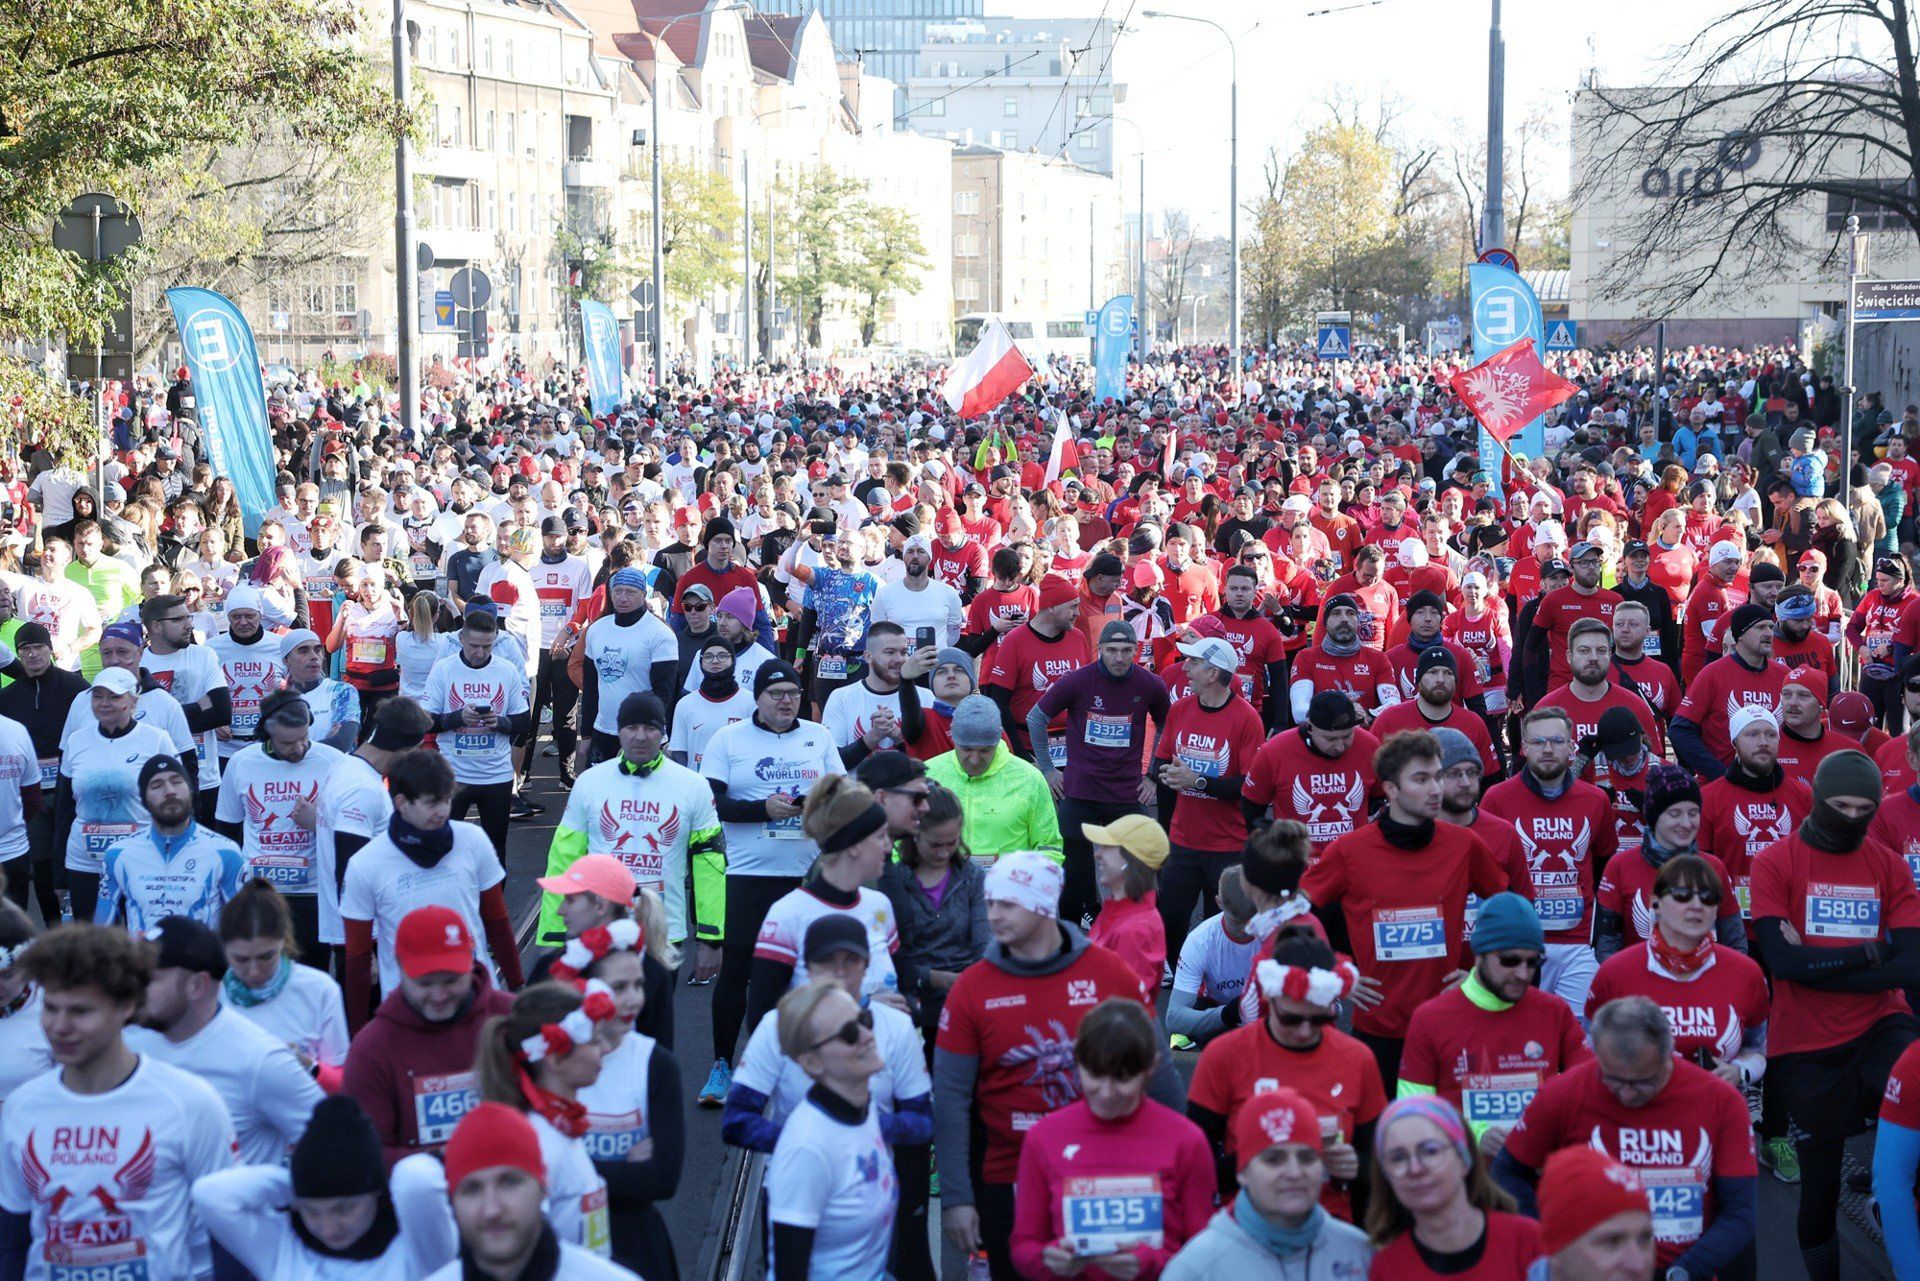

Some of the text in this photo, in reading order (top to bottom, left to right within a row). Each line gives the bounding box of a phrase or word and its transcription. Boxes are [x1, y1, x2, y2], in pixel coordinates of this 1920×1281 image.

[999, 605, 1021, 613] RUN
[234, 662, 261, 672] RUN
[1046, 661, 1070, 670] RUN
[464, 683, 490, 693] RUN
[1743, 691, 1771, 703] RUN
[1093, 724, 1124, 735] 3312
[1577, 724, 1598, 735] RU
[458, 736, 489, 746] 4110
[1187, 734, 1216, 749] RUN
[766, 770, 818, 779] WORLD RUN
[1310, 773, 1346, 787] RUN
[265, 782, 300, 795] RUN
[1311, 784, 1346, 795] POLAND
[621, 800, 659, 814] RUN
[1748, 803, 1776, 814] RUN
[619, 813, 660, 823] POLAND
[1533, 818, 1573, 831] RUN
[1309, 822, 1352, 835] TEAM
[262, 832, 308, 844] TEAM
[1534, 831, 1573, 840] POLAND
[258, 868, 299, 881] 1492
[1531, 872, 1577, 885] TEAM
[1533, 902, 1576, 915] 4393
[1818, 899, 1869, 920] 5816
[1385, 923, 1434, 943] 2775
[1660, 1005, 1715, 1026] RUN
[1669, 1025, 1717, 1037] OLAND
[54, 1126, 119, 1150] RUN
[1619, 1127, 1682, 1152] RUN
[51, 1151, 117, 1165] POLAND
[1621, 1151, 1684, 1165] POLAND
[1080, 1199, 1146, 1227] 1135
[46, 1218, 130, 1245] TEAM
